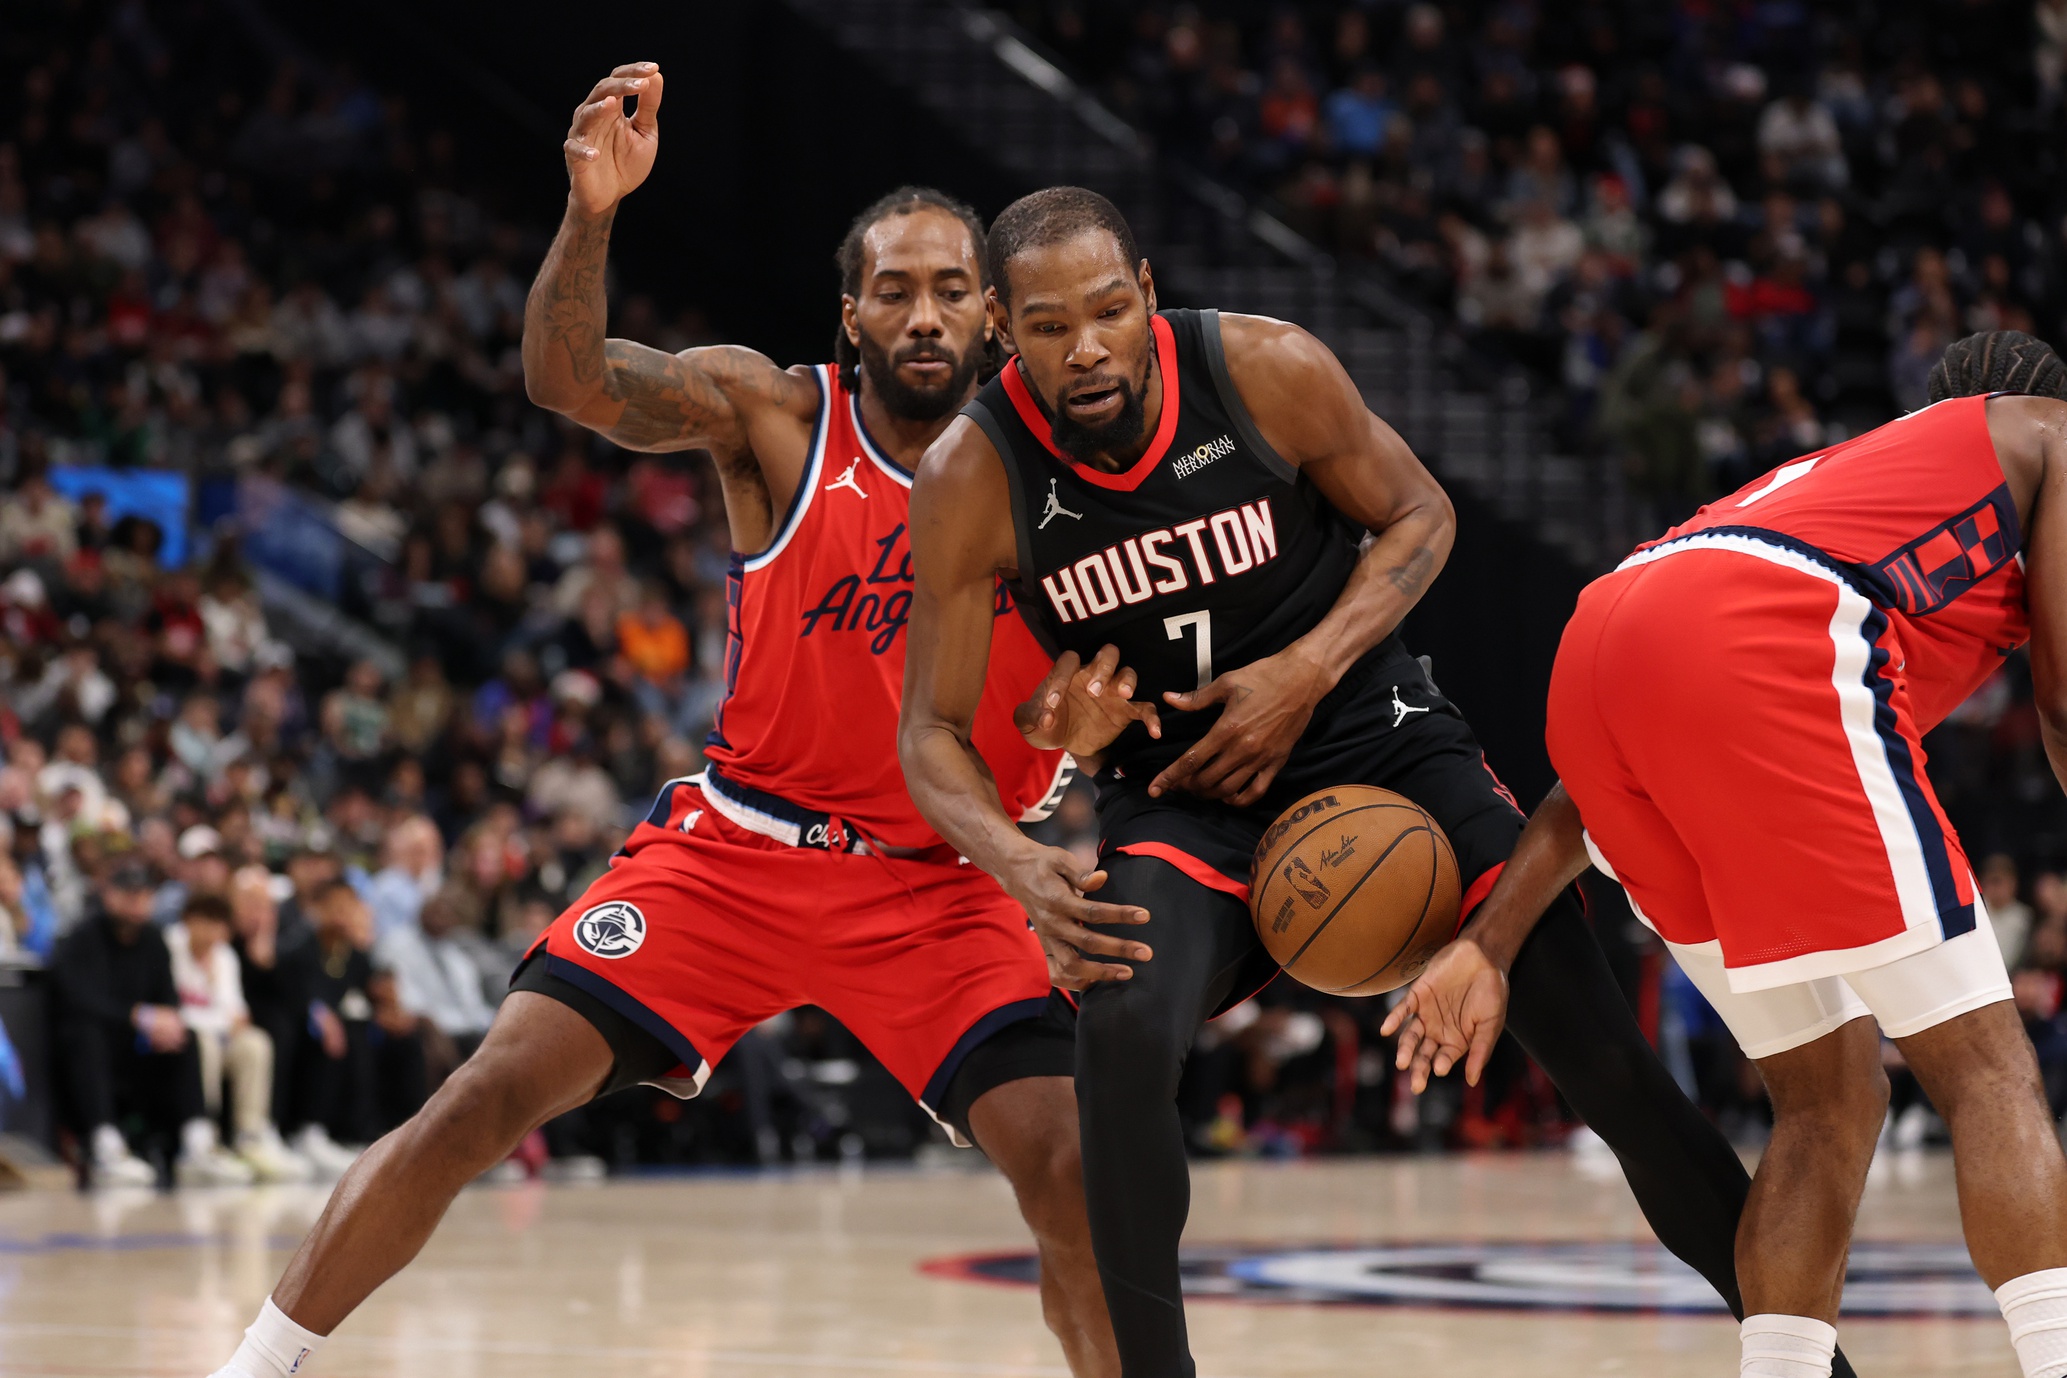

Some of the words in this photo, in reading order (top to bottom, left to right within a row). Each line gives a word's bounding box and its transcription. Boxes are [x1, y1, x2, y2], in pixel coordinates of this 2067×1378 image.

[1172, 434, 1234, 470] MEMORIAL
[1174, 441, 1236, 480] HERMANN
[1039, 496, 1279, 625] HOUSTON
[1163, 609, 1213, 691] 7
